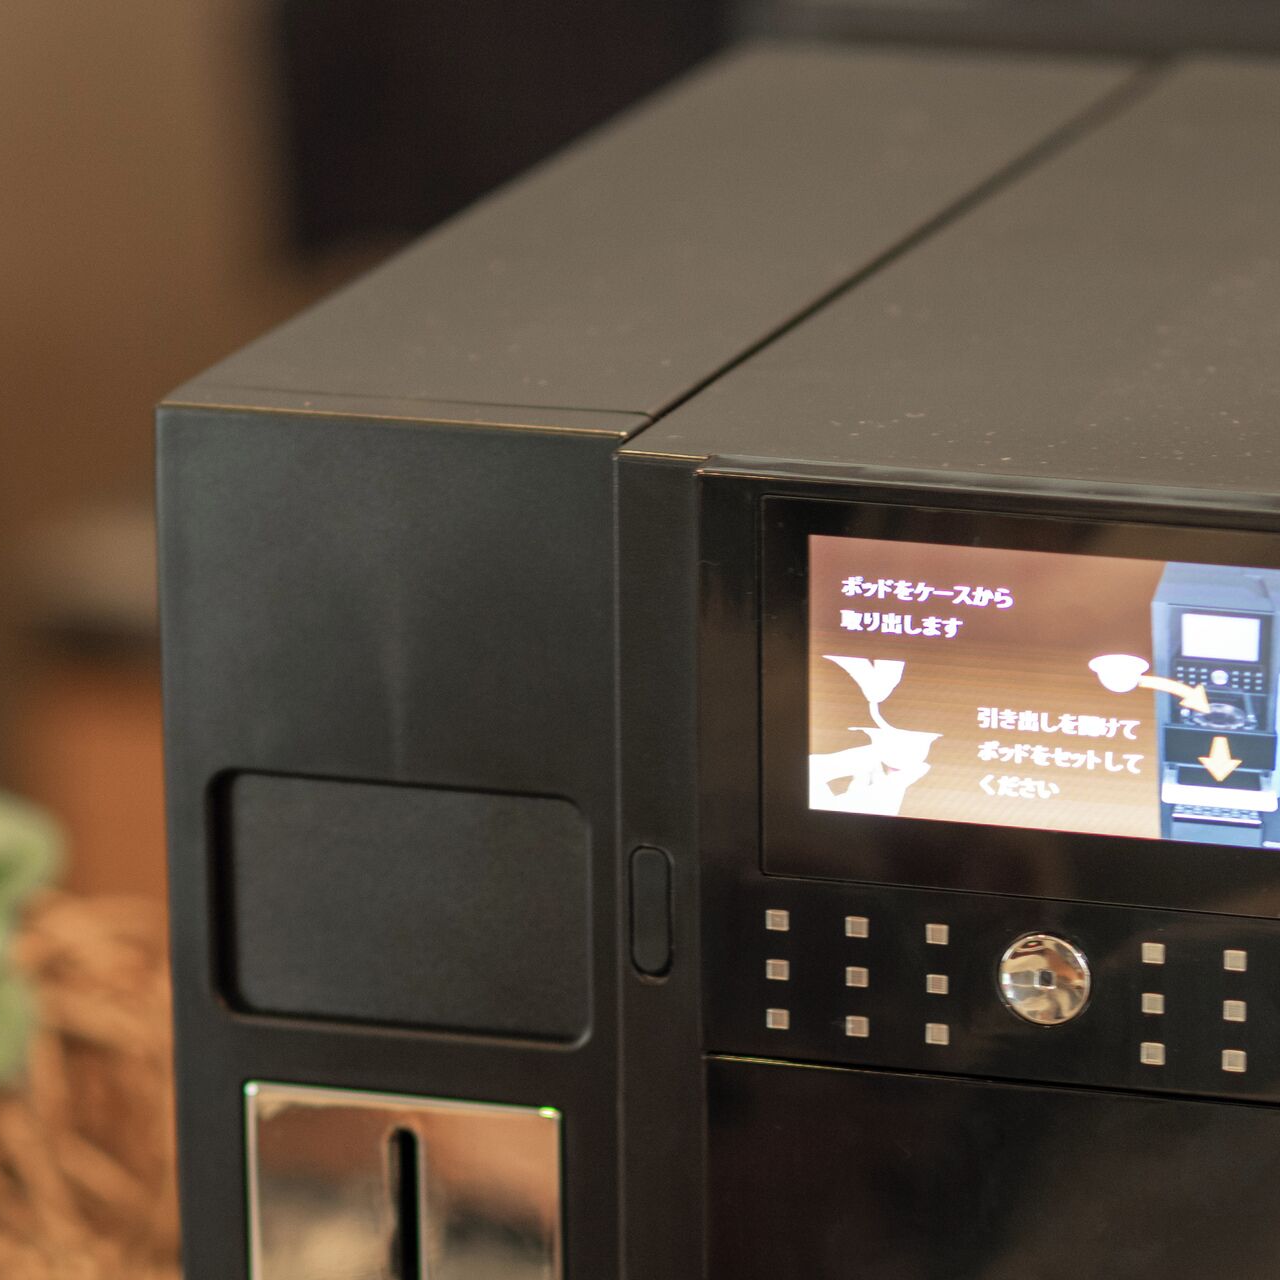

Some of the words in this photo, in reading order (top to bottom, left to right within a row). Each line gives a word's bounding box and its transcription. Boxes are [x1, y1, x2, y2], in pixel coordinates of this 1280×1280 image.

[841, 576, 1014, 609] ポッドをケースから
[840, 610, 963, 638] 取り出します
[977, 741, 1144, 774] ポッドをセットして
[979, 774, 1060, 799] ください
